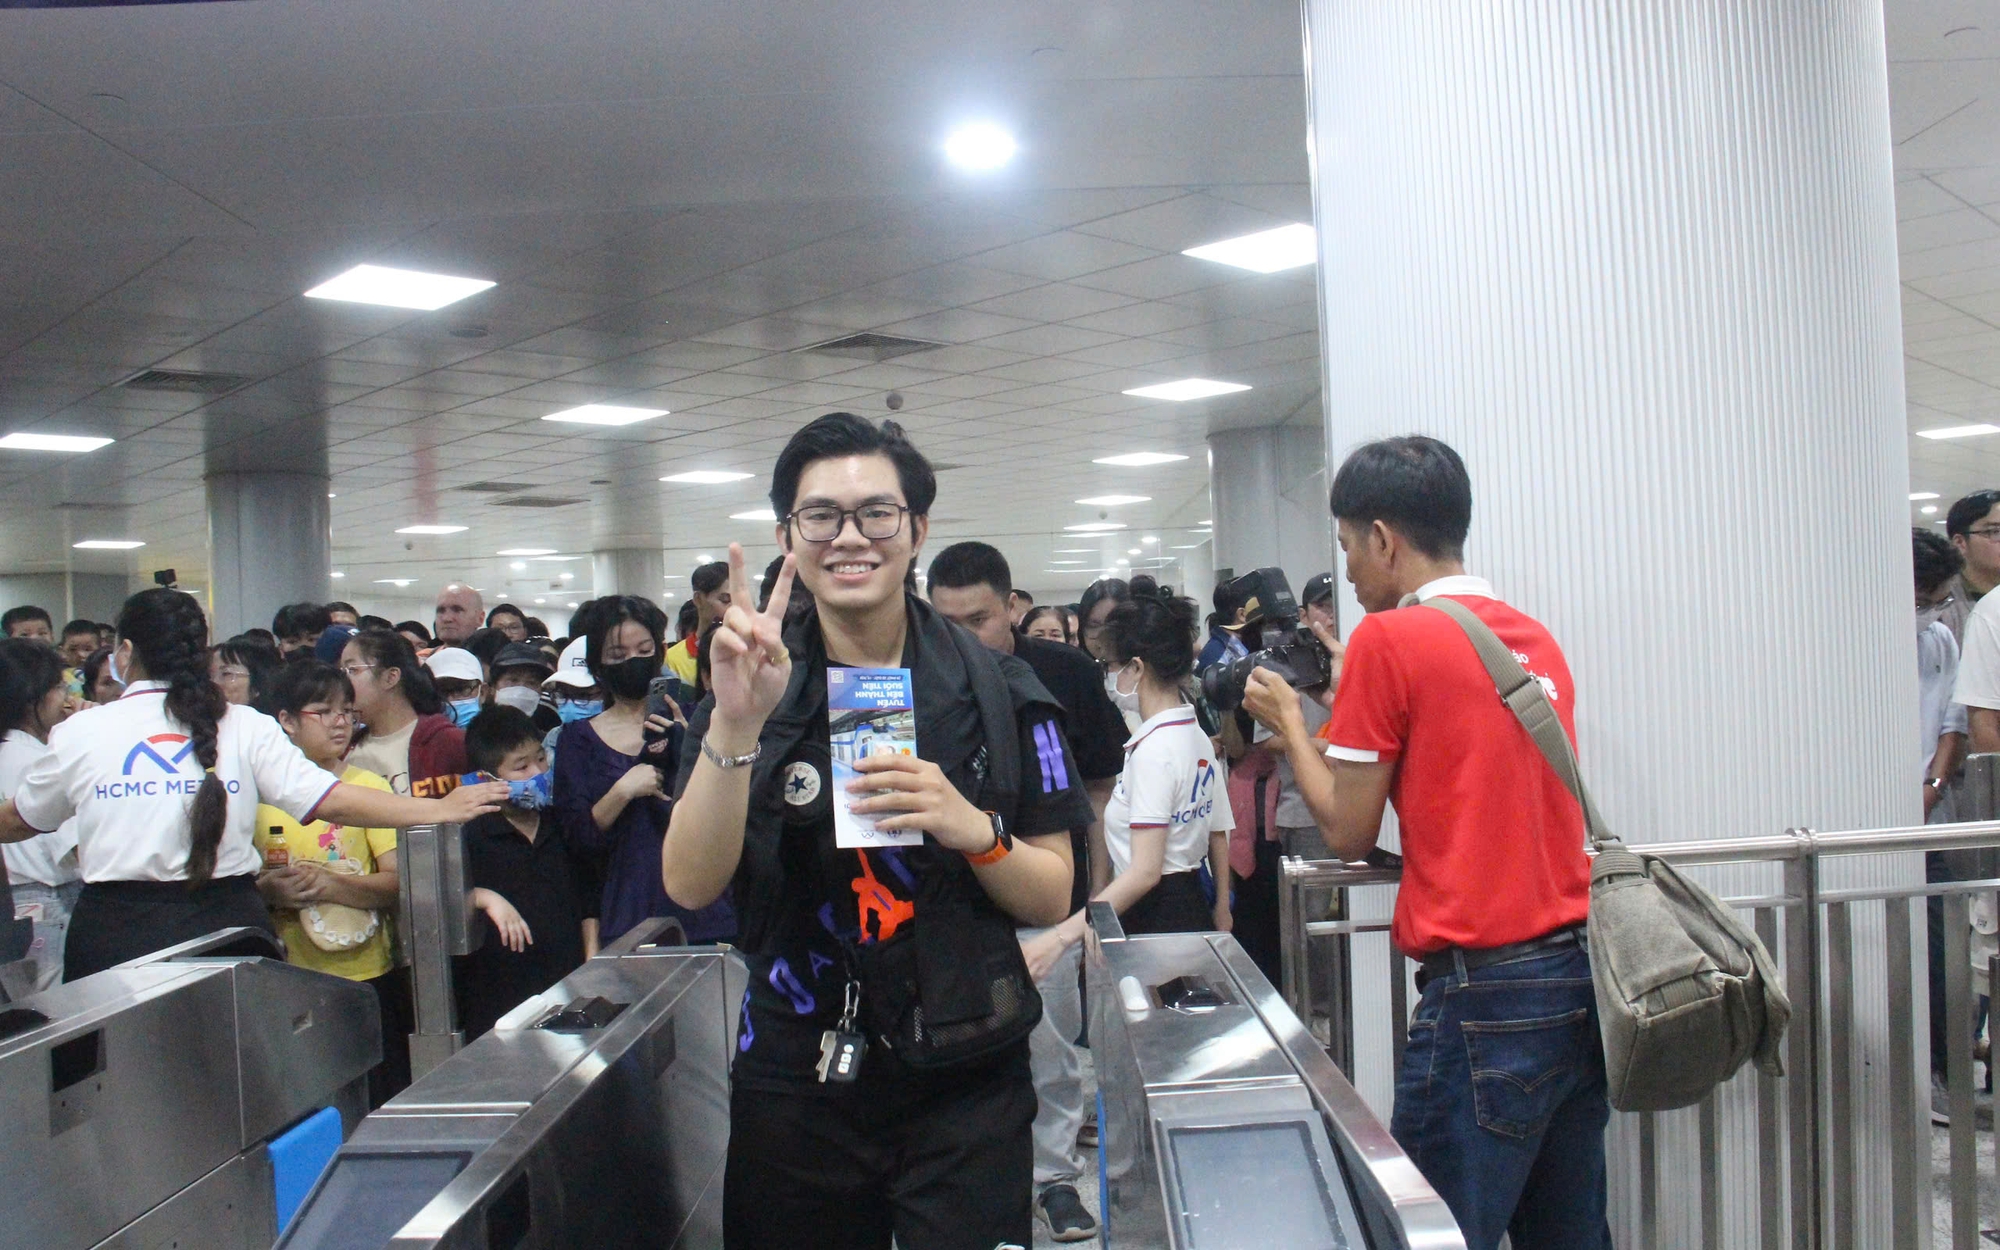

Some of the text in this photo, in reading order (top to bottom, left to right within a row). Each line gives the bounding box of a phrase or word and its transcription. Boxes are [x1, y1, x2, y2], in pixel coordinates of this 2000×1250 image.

[862, 682, 904, 690] SUỐI TIÊN
[855, 691, 904, 700] BẾN THÀNH
[877, 699, 905, 708] TUYẾN
[95, 779, 240, 800] HCMC MEO
